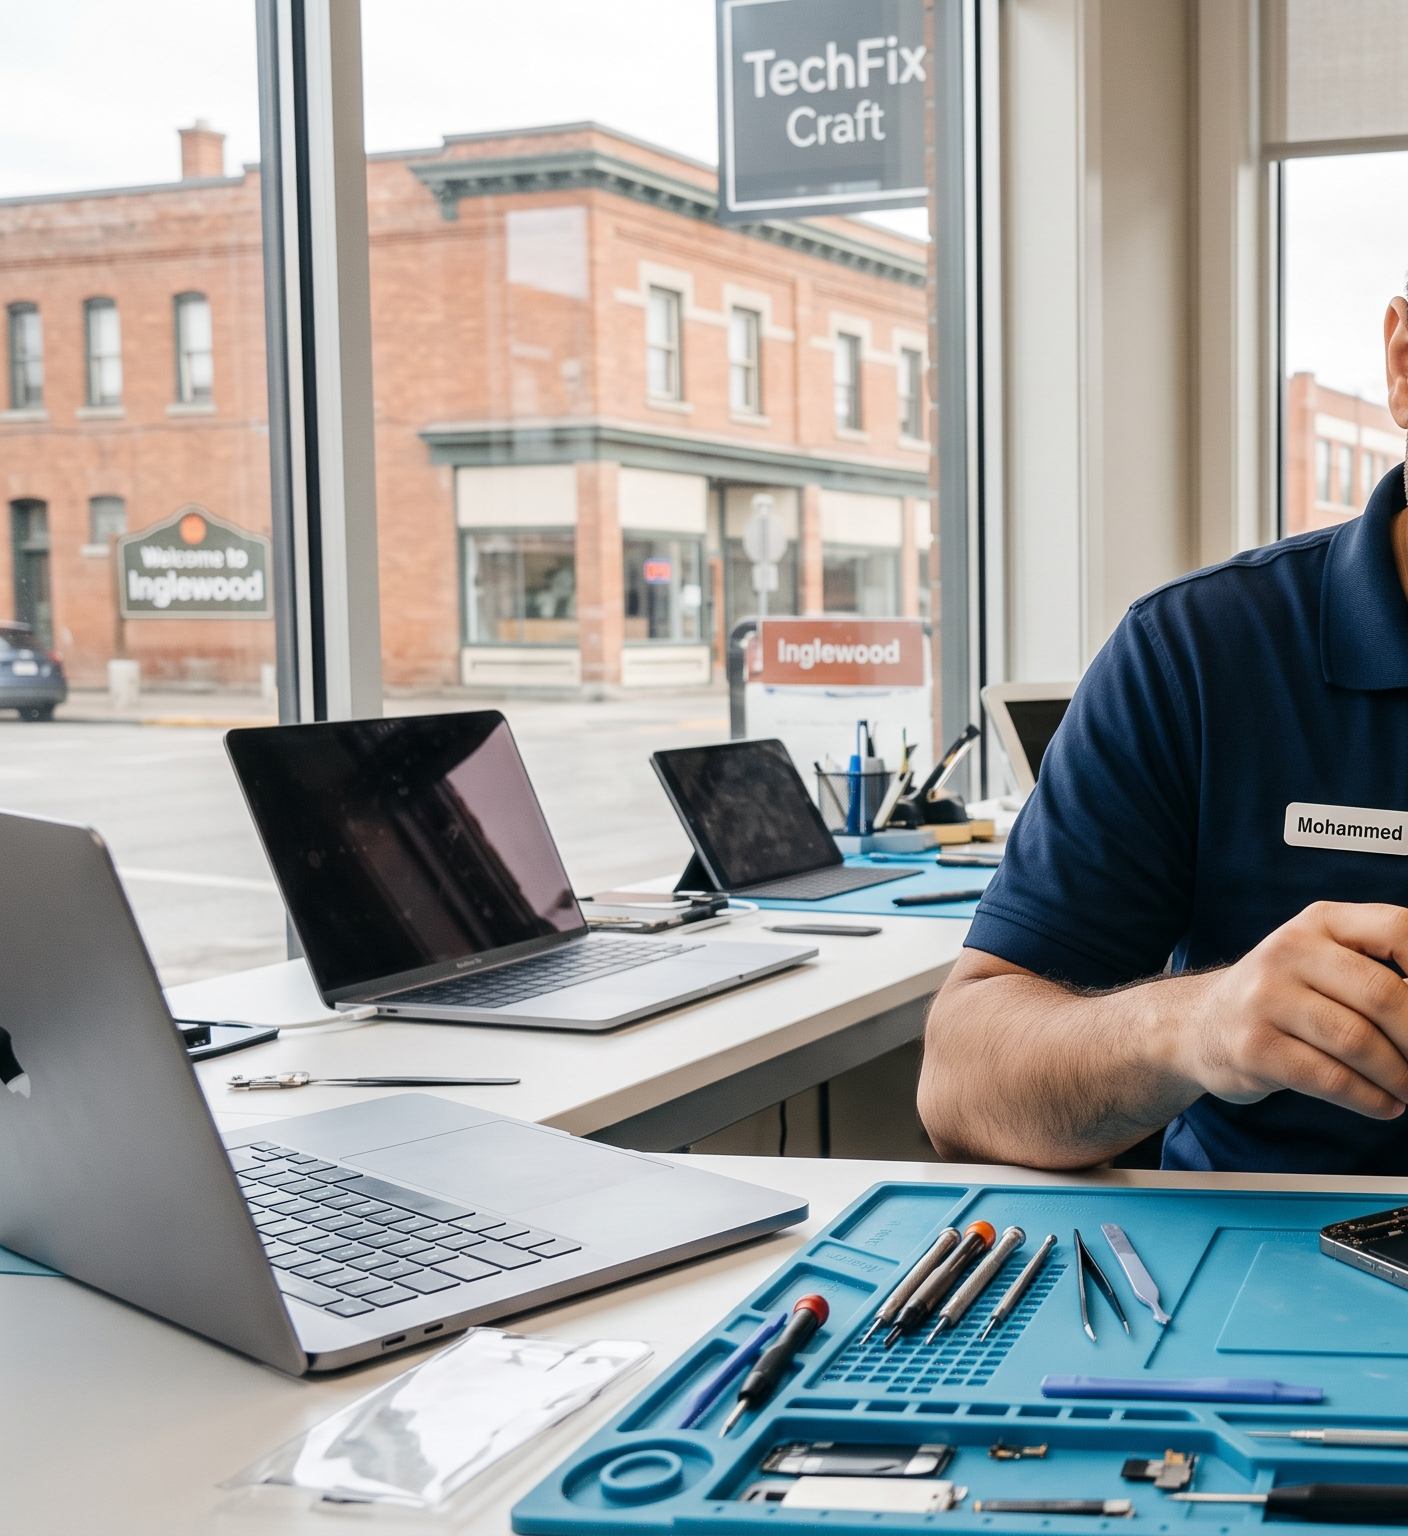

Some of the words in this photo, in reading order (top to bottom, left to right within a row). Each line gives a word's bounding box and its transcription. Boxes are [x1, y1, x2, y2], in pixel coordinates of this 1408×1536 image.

[743, 35, 927, 98] TechFix
[786, 99, 886, 148] Craft
[140, 546, 224, 569] Welcome
[226, 547, 248, 569] to
[128, 569, 263, 608] Inglewood
[778, 638, 900, 670] Inglewood
[1297, 817, 1403, 841] Mohammed
